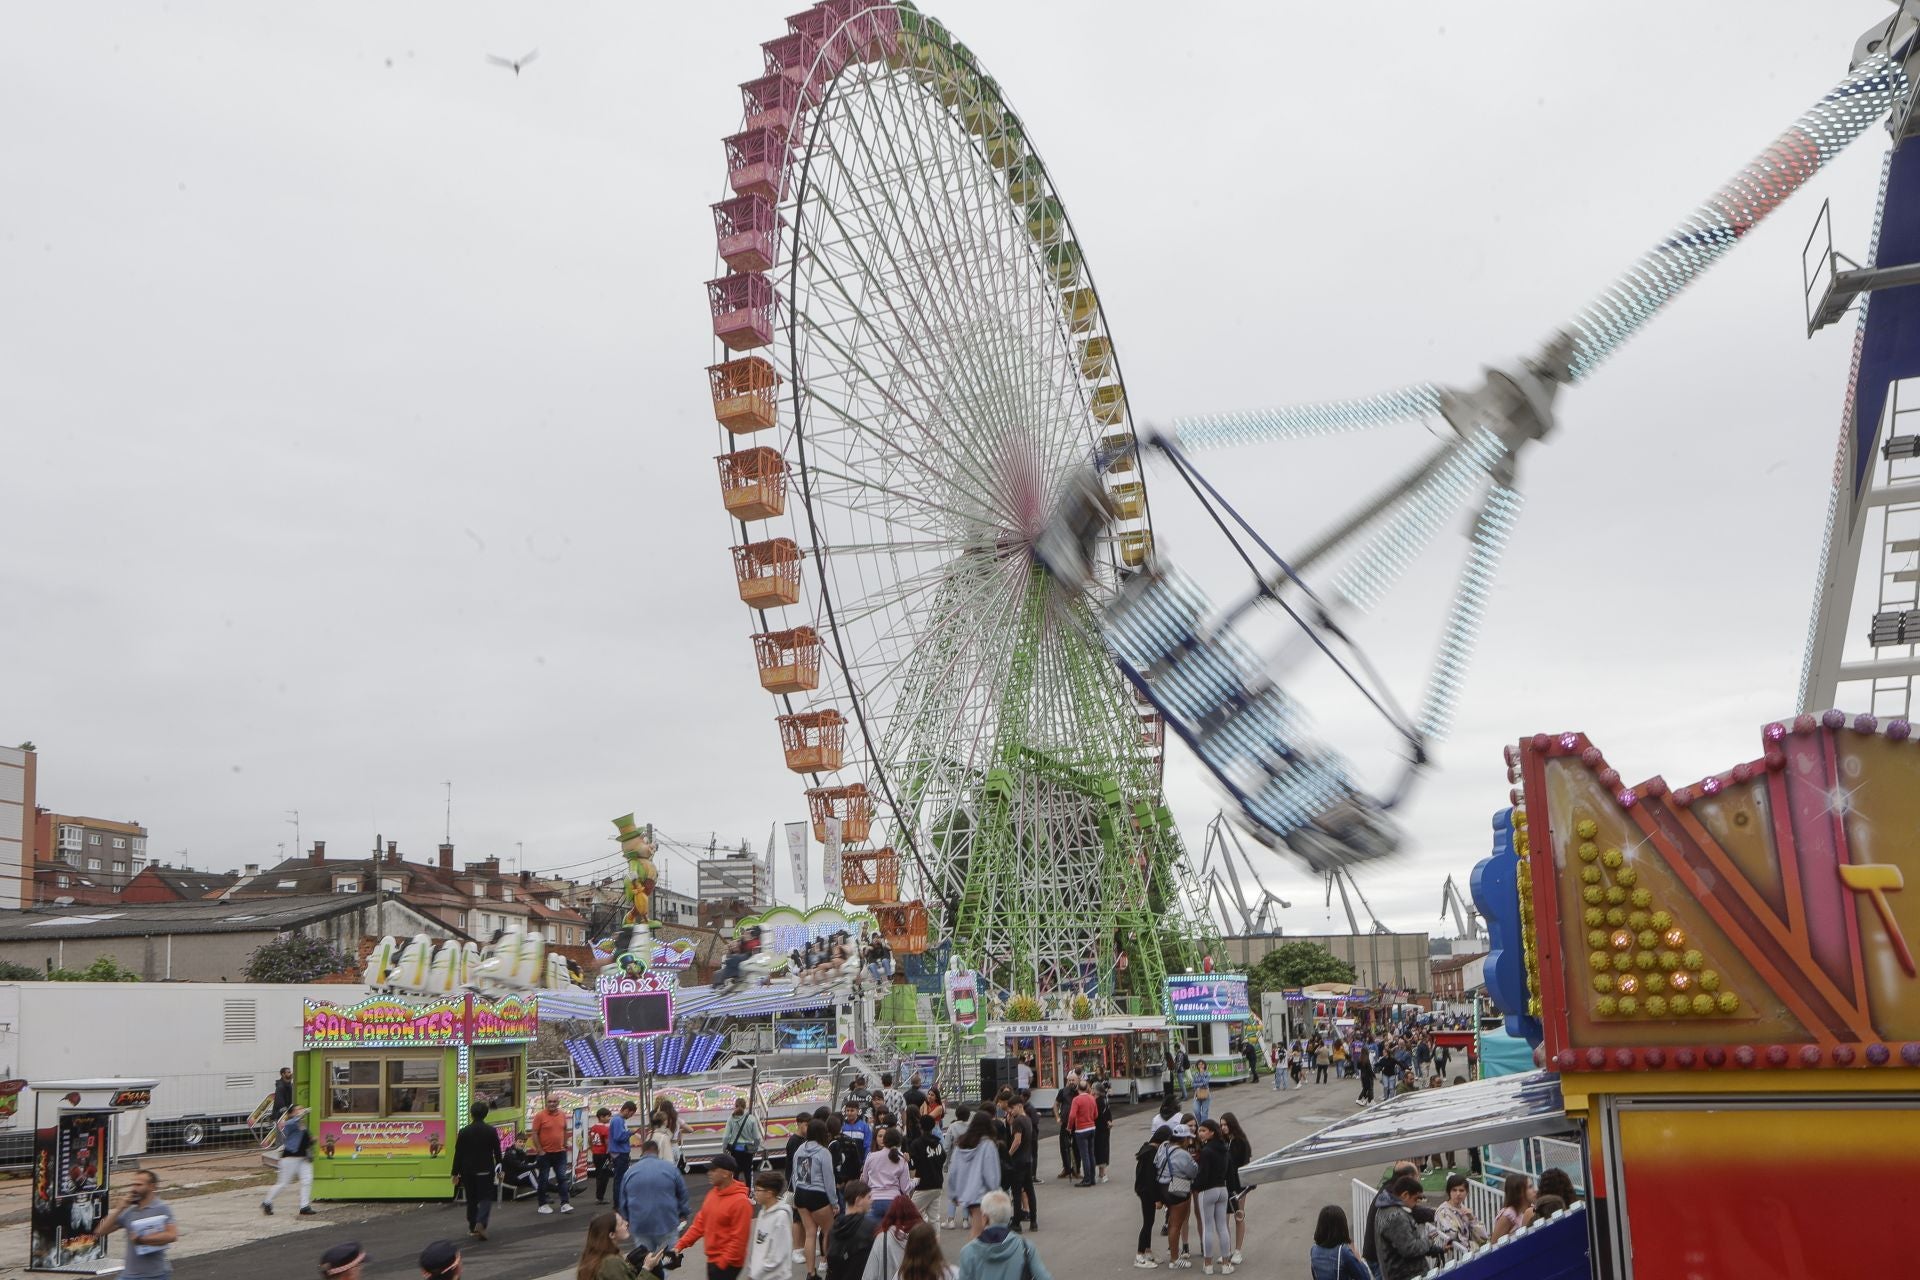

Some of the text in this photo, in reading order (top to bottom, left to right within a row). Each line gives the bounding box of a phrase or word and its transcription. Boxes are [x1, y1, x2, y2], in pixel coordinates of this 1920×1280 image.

[600, 975, 670, 994] MAXX
[1171, 984, 1209, 1001] NORIA
[1174, 1002, 1209, 1011] TAQUILLA
[363, 1007, 406, 1023] MAXX
[314, 1010, 453, 1041] SALTAMONTES
[354, 1133, 410, 1145] MAXX
